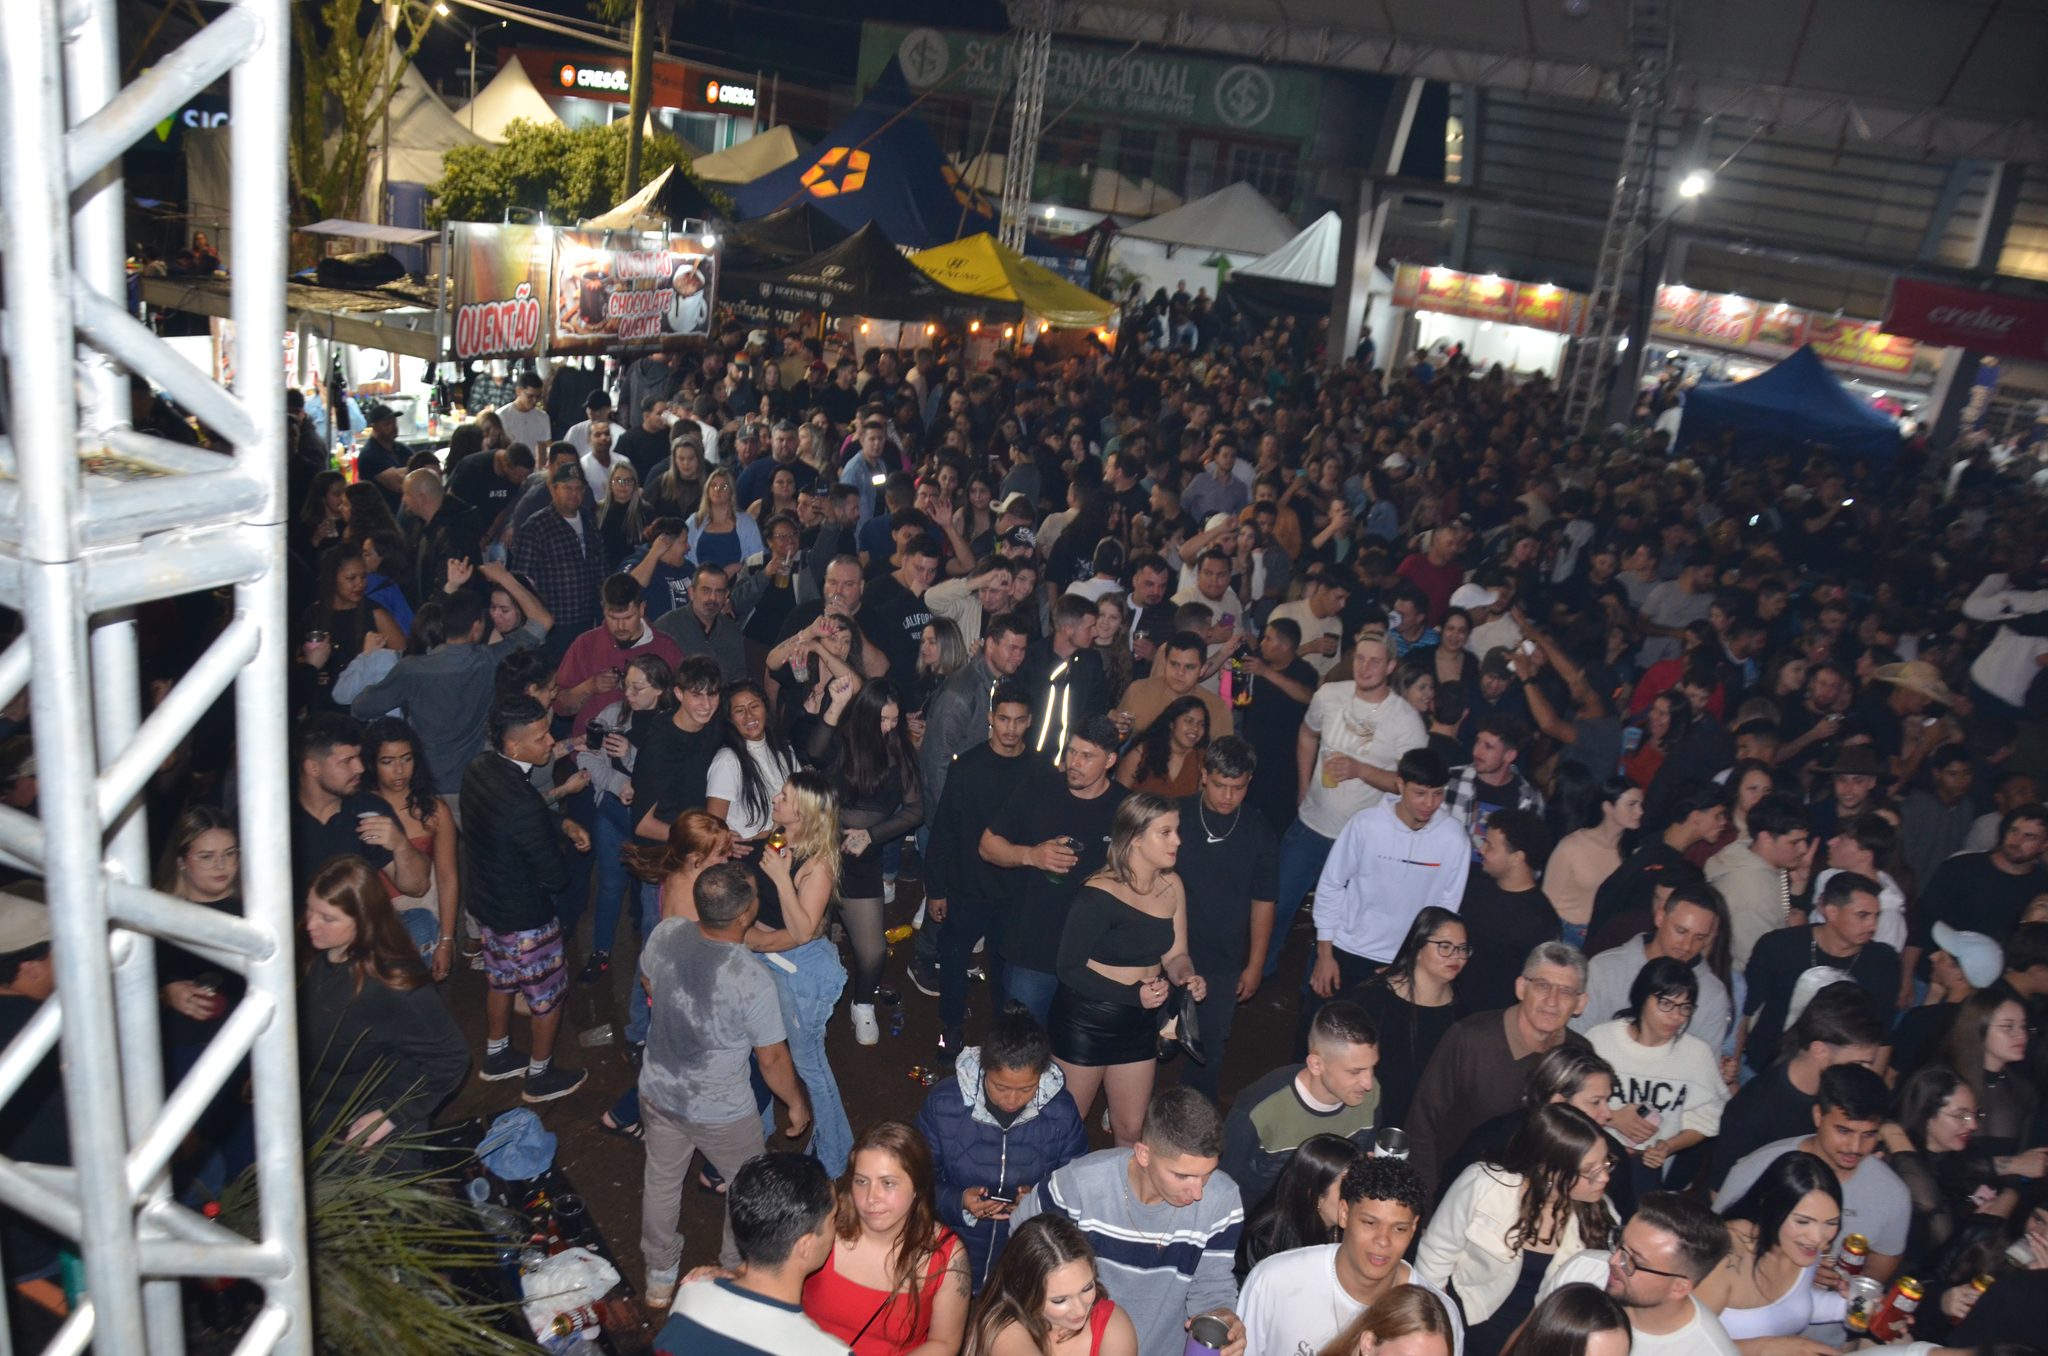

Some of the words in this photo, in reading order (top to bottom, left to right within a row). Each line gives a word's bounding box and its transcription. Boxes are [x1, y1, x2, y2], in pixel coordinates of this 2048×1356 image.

[577, 69, 629, 91] CRESOL
[719, 85, 756, 106] CRESOL
[608, 288, 674, 317] CHOCOLATE
[456, 281, 541, 358] QUENTÃO
[617, 316, 662, 341] QUENTE
